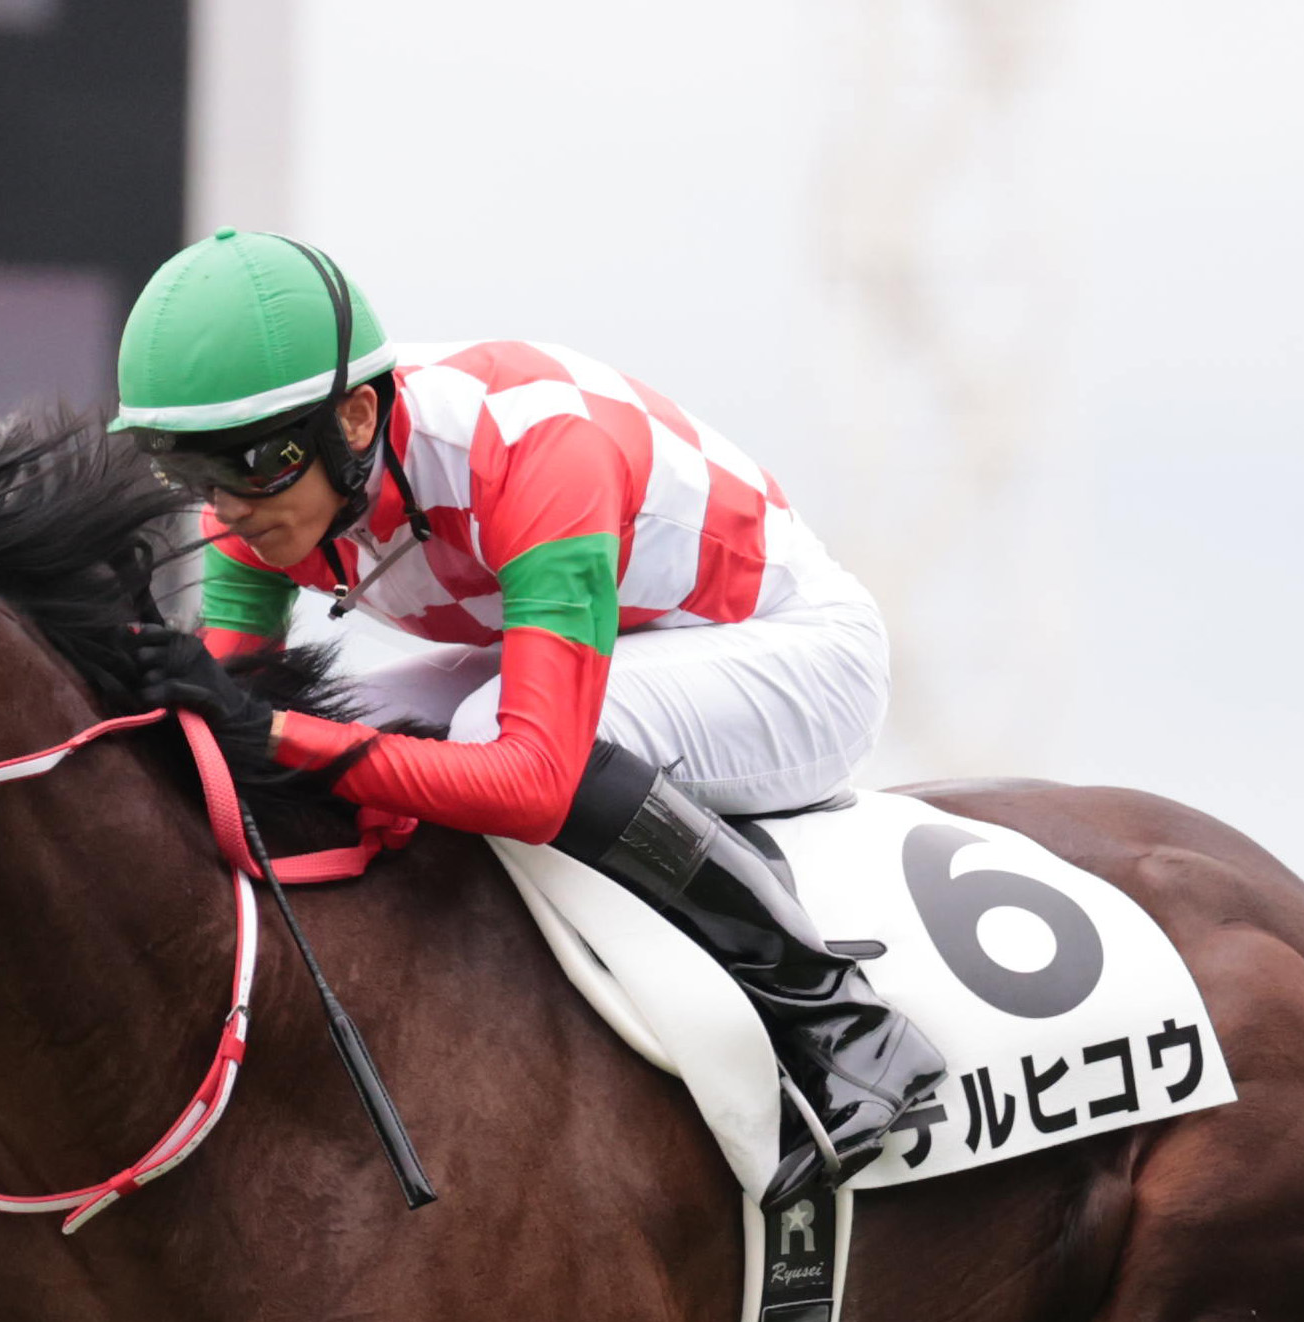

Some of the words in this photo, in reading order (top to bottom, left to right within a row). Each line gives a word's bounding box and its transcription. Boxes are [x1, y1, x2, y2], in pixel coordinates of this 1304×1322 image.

[901, 823, 1104, 1019] 6
[888, 1018, 1204, 1169] テルヒコウ
[770, 1261, 825, 1286] Ryusei
